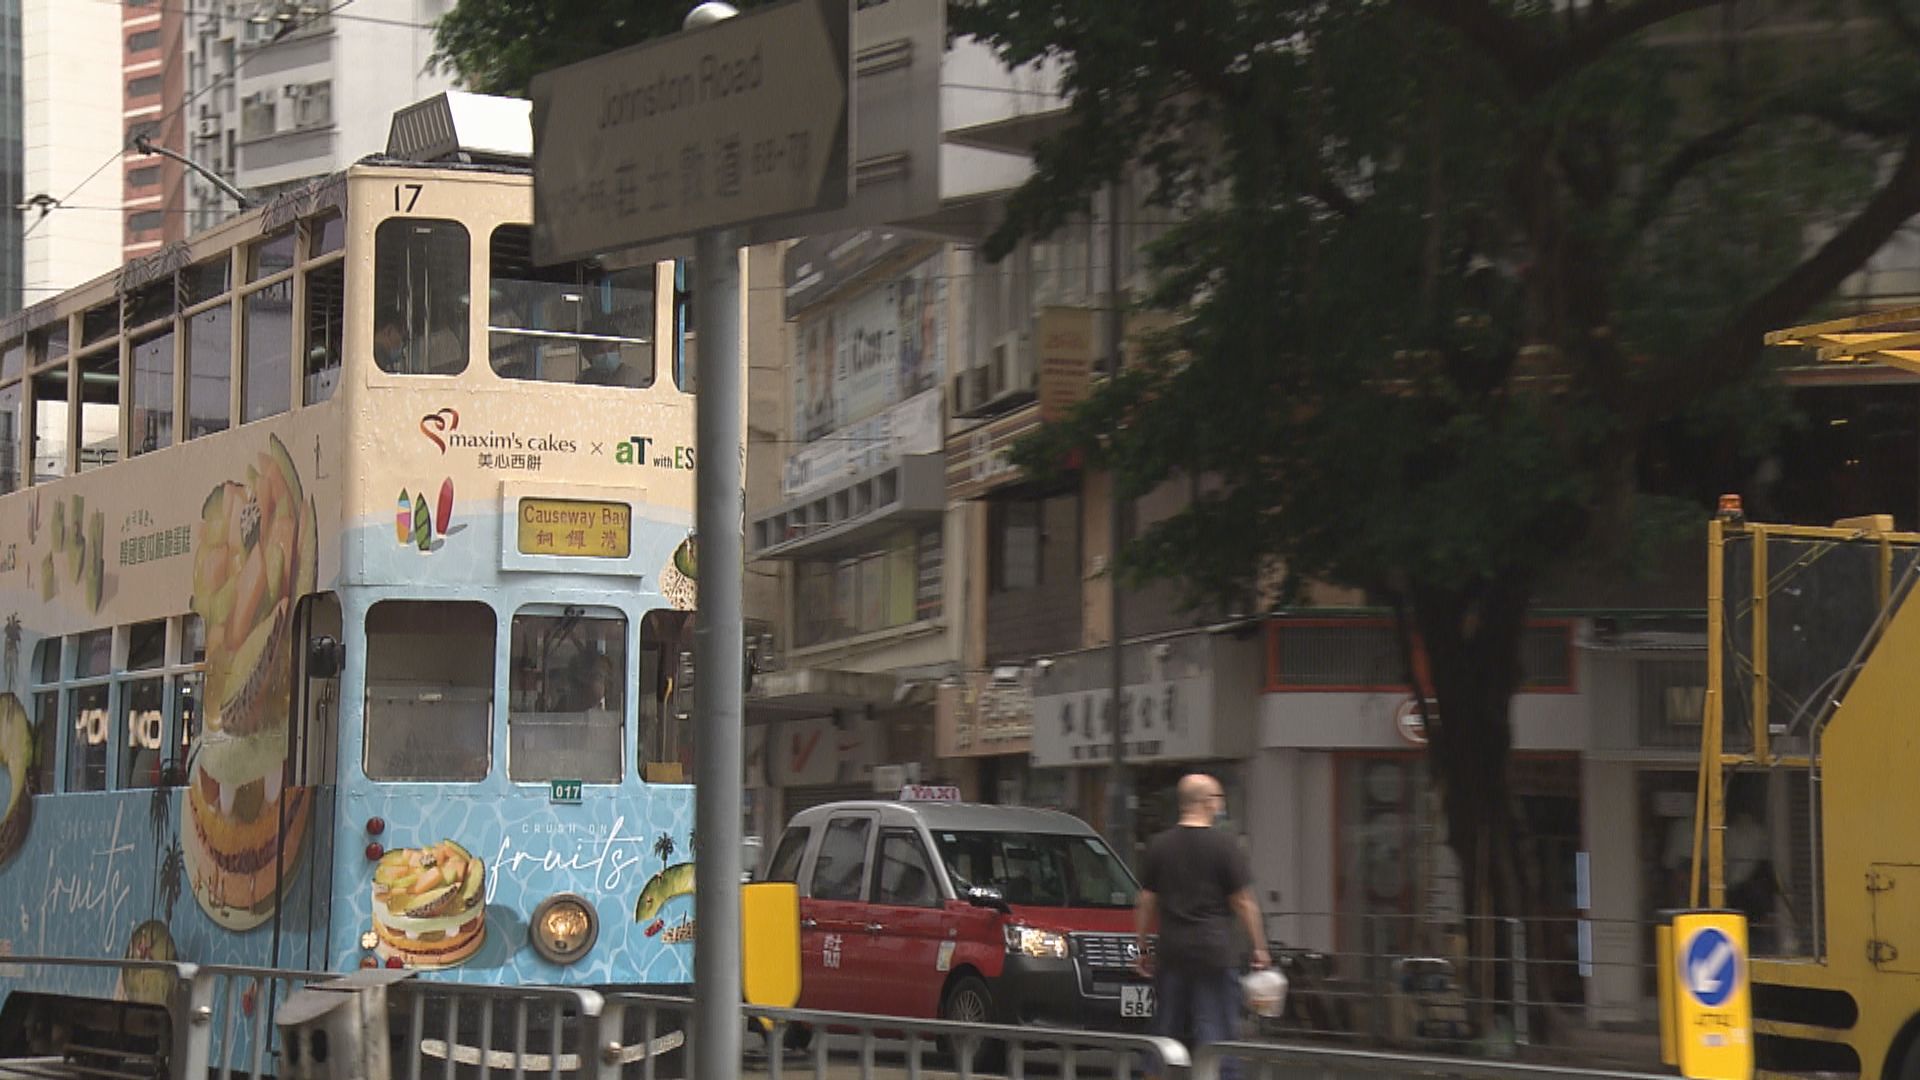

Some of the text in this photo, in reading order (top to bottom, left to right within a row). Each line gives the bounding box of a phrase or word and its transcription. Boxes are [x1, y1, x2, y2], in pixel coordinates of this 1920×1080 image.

[394, 184, 423, 213] 17
[449, 429, 522, 450] maxim's
[527, 433, 577, 453] cakes
[653, 456, 673, 469] with
[674, 446, 695, 470] ES
[523, 504, 628, 530] Causeway Bay
[536, 529, 617, 550] 銅鑼灣
[555, 785, 580, 799] 017
[911, 786, 957, 800] TAXI
[522, 823, 608, 835] CRUSH ON
[486, 815, 644, 905] fruits
